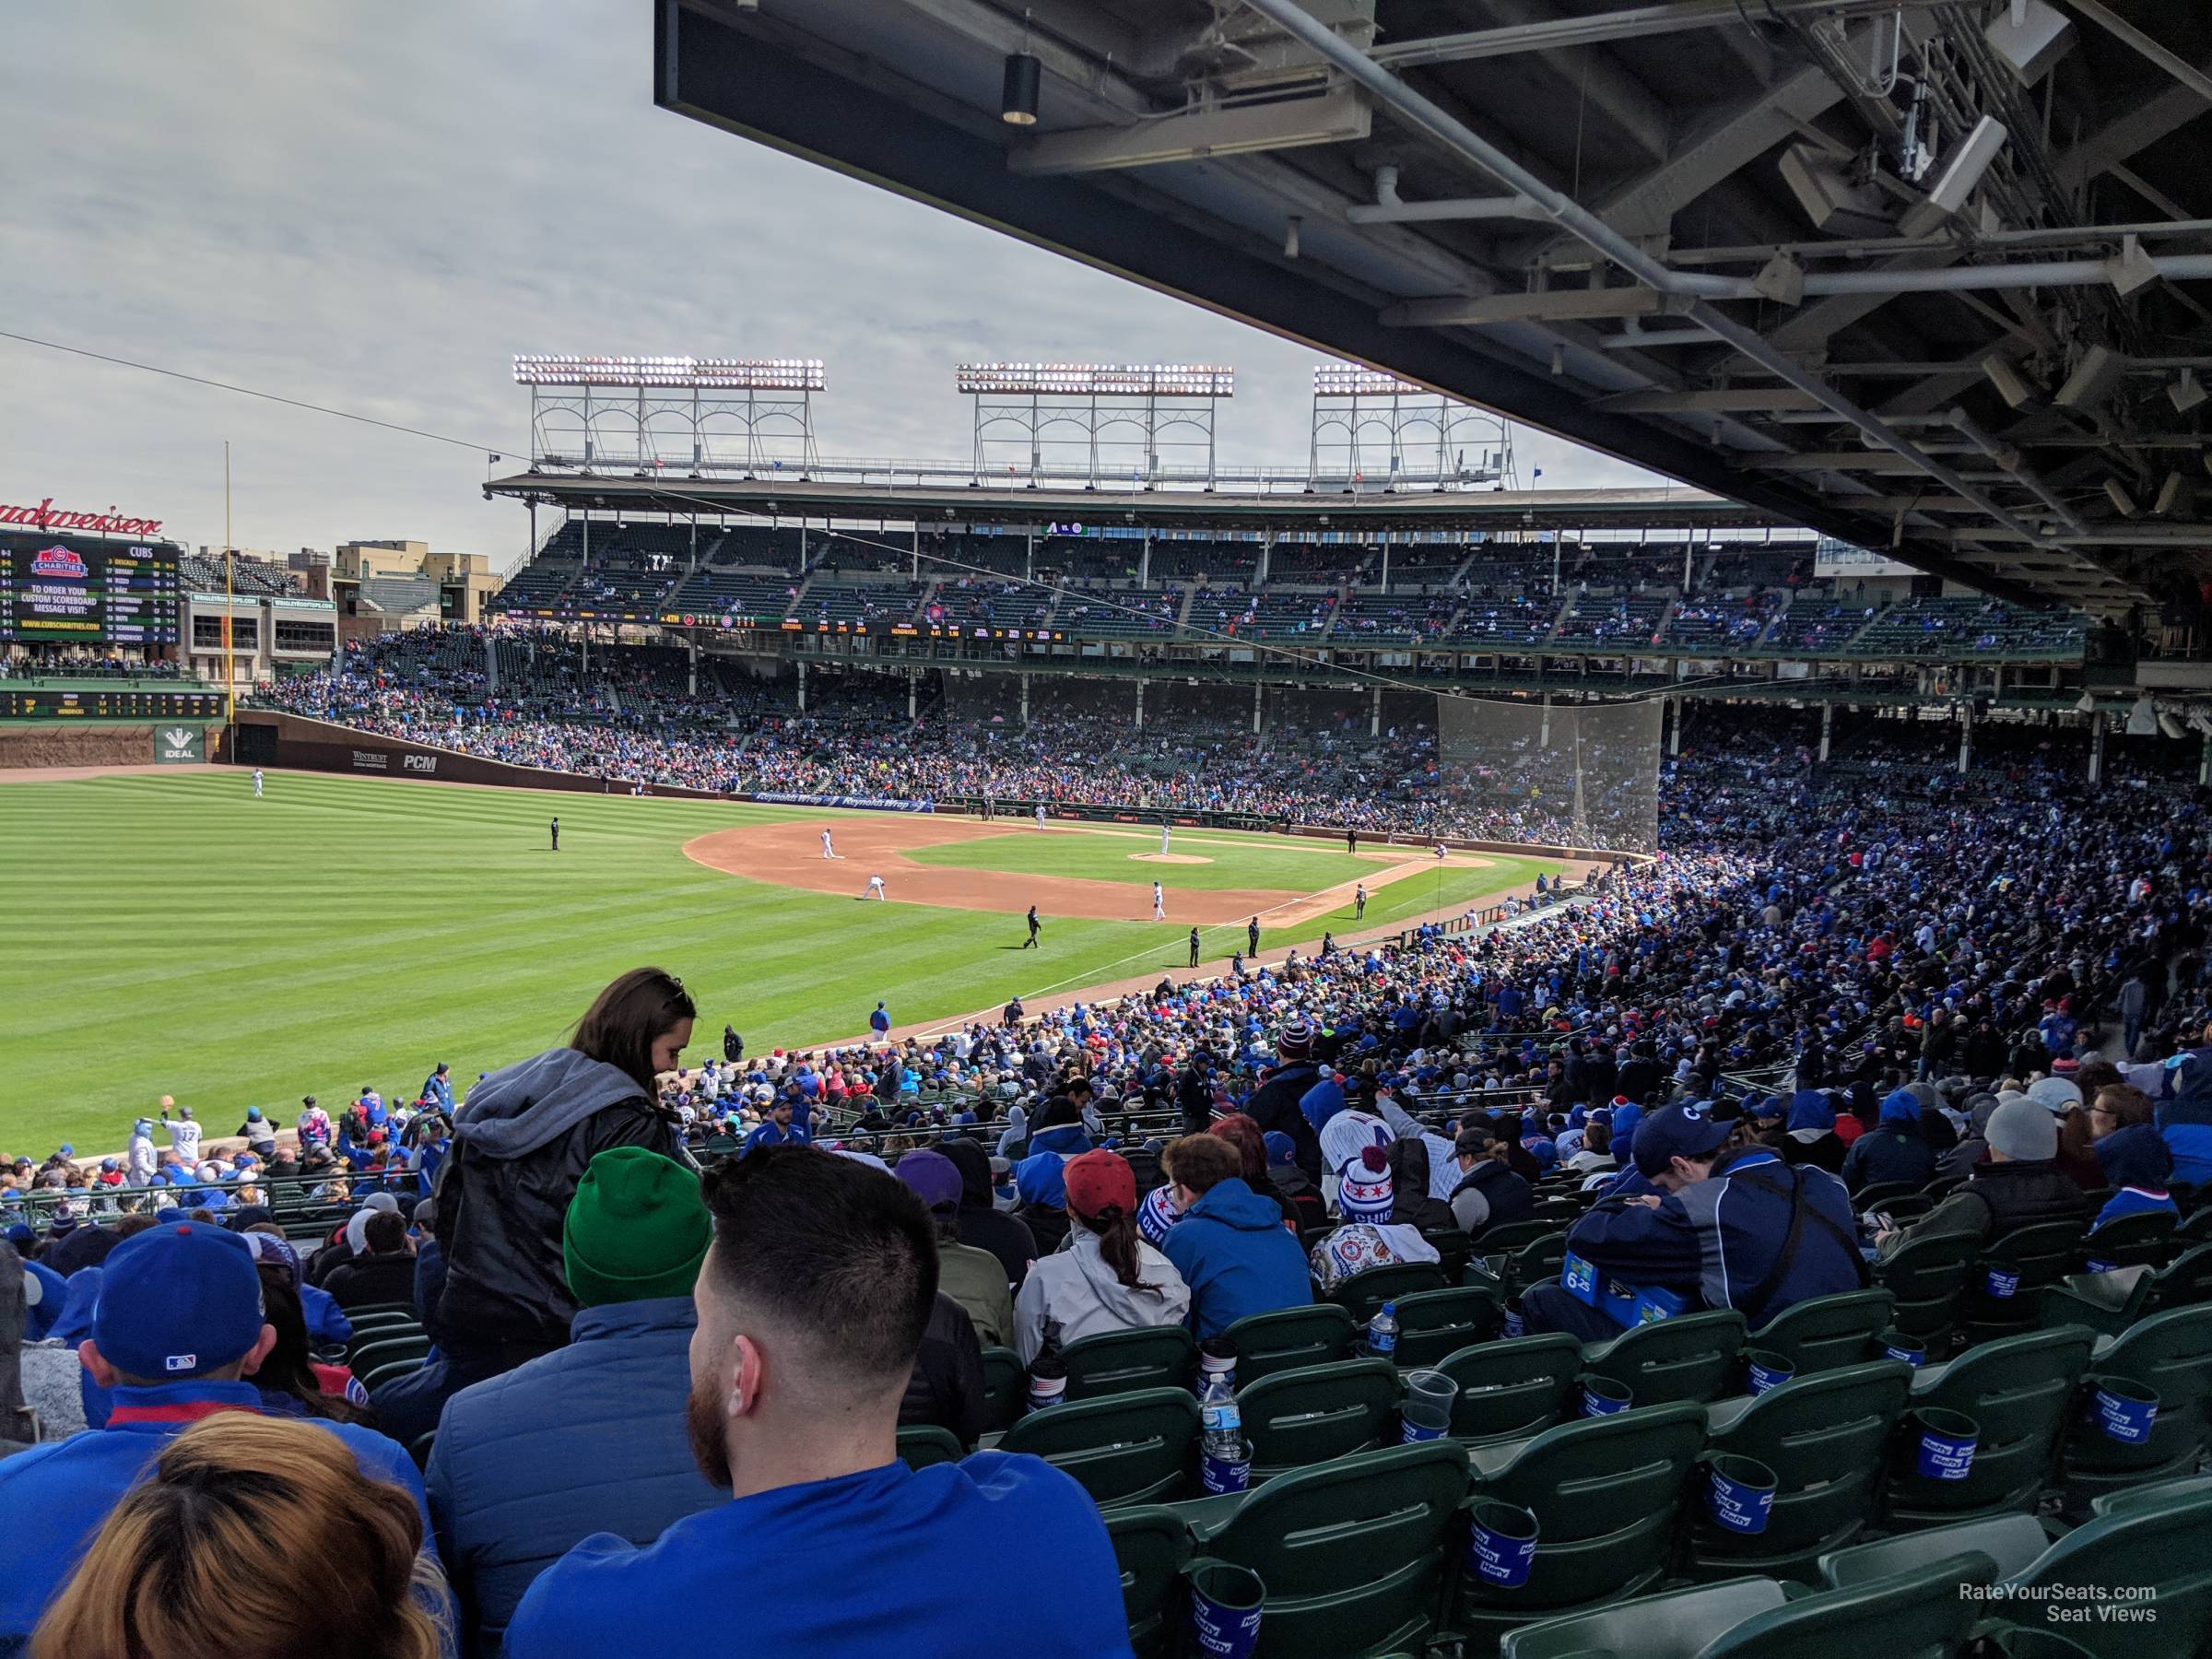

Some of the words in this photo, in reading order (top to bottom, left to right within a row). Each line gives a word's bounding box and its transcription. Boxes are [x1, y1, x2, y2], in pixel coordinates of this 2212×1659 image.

[130, 547, 153, 558] CUBS
[39, 562, 81, 571] CHARITIES
[43, 586, 66, 594] ORDER
[67, 587, 87, 595] YOUR
[21, 594, 51, 603] CUSTOM
[53, 596, 97, 606] SCOREBOARD
[194, 594, 256, 604] WRIGLEYROOTOPS.COM
[34, 604, 65, 613] MESSAGE
[666, 615, 679, 623] 4TH
[353, 751, 387, 762] WINTRUST
[404, 754, 437, 770] PCM
[756, 792, 797, 803] Reynolds
[798, 795, 822, 805] Wrap
[843, 797, 882, 808] Reynolds
[884, 800, 909, 810] Wrap
[183, 1131, 195, 1141] 17
[2111, 1424, 2138, 1437] Hefty
[1924, 1439, 1951, 1454] Hefty
[1934, 1457, 1960, 1467] Hefty
[1722, 1509, 1750, 1525] Hefty
[1482, 1563, 1509, 1577] Hefty
[1201, 1635, 1231, 1652] Hefty
